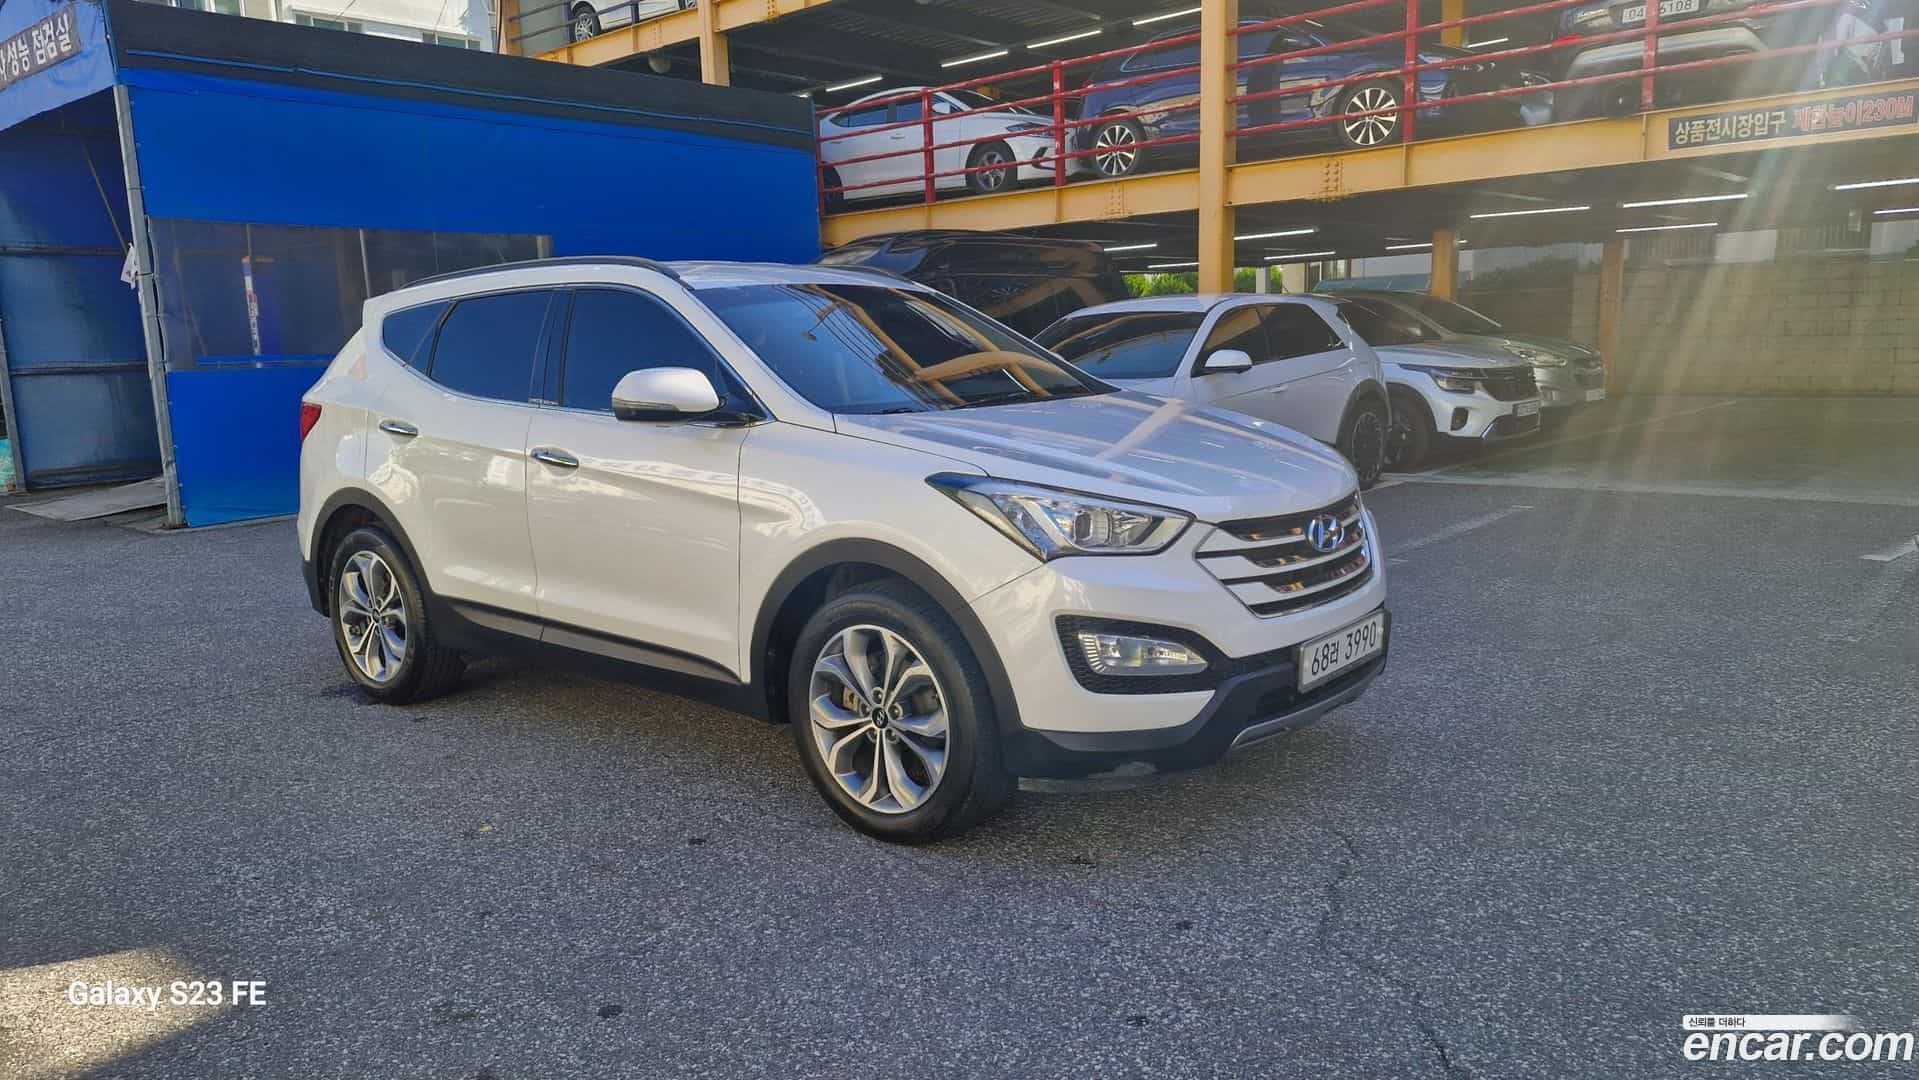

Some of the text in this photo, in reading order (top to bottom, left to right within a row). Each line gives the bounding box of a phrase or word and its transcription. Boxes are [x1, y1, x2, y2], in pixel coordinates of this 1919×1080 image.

[31, 13, 72, 65] 점검실
[1675, 111, 1786, 144] 상품전시장입구
[1311, 621, 1377, 676] 68러 3990
